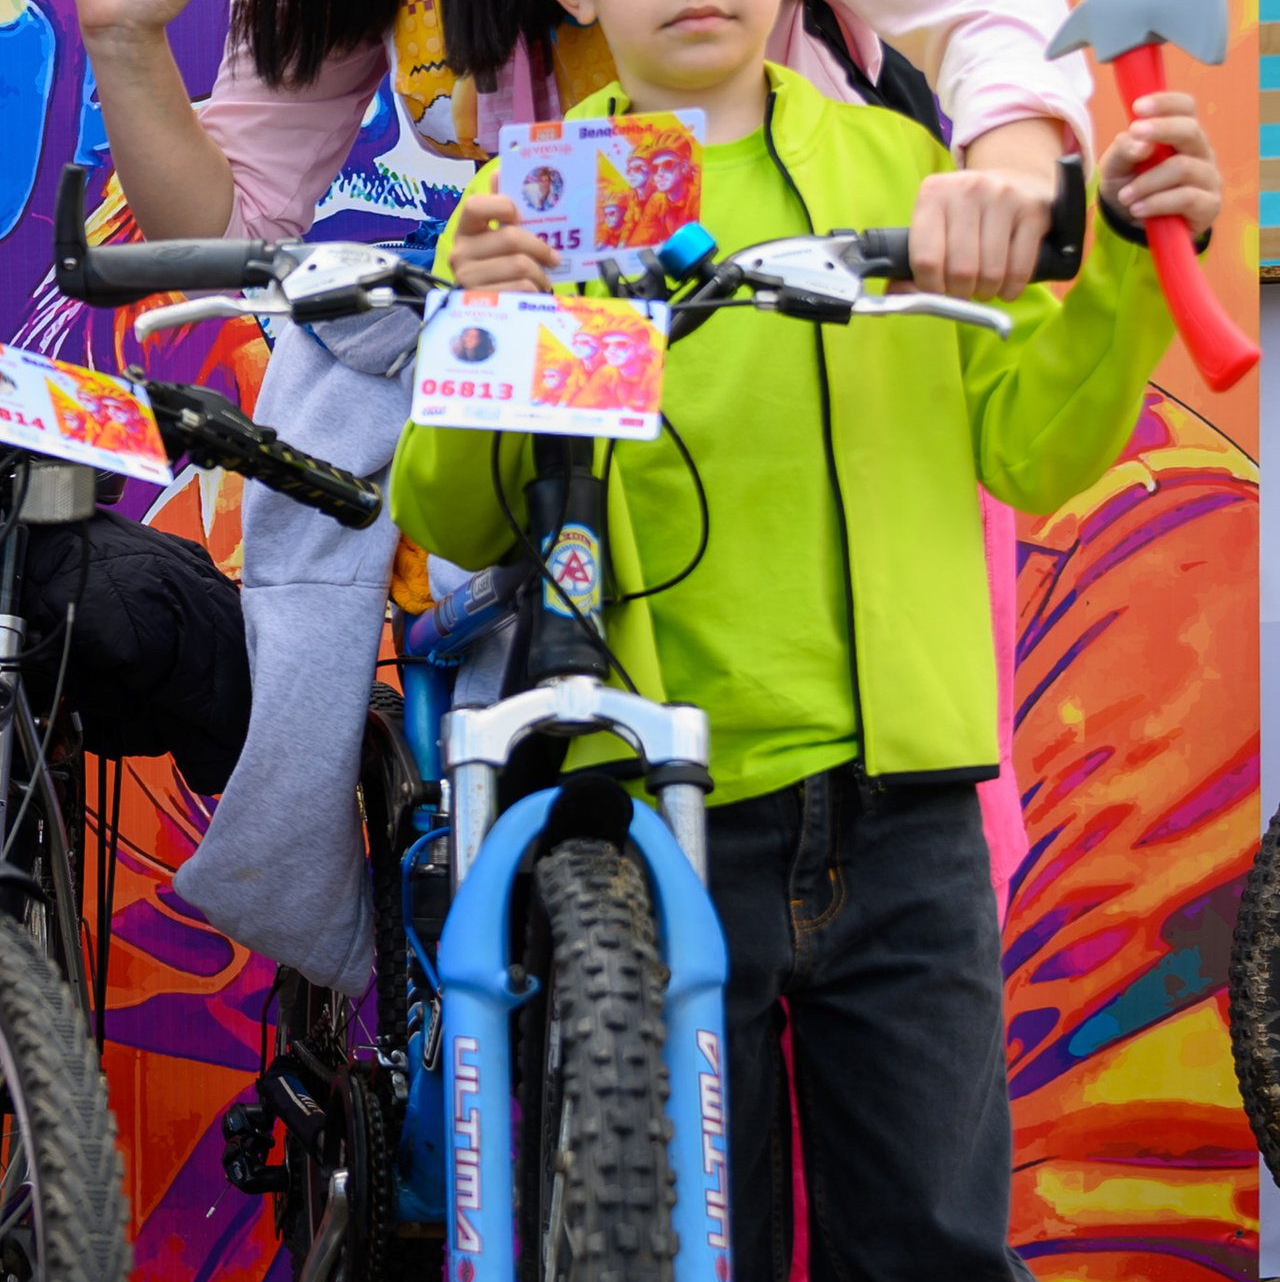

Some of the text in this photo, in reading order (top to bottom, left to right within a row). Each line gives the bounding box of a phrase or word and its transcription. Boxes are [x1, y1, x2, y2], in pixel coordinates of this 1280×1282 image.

[421, 378, 514, 401] 06813
[453, 1036, 481, 1253] ULTIMA
[696, 1029, 729, 1250] ULTIMA
